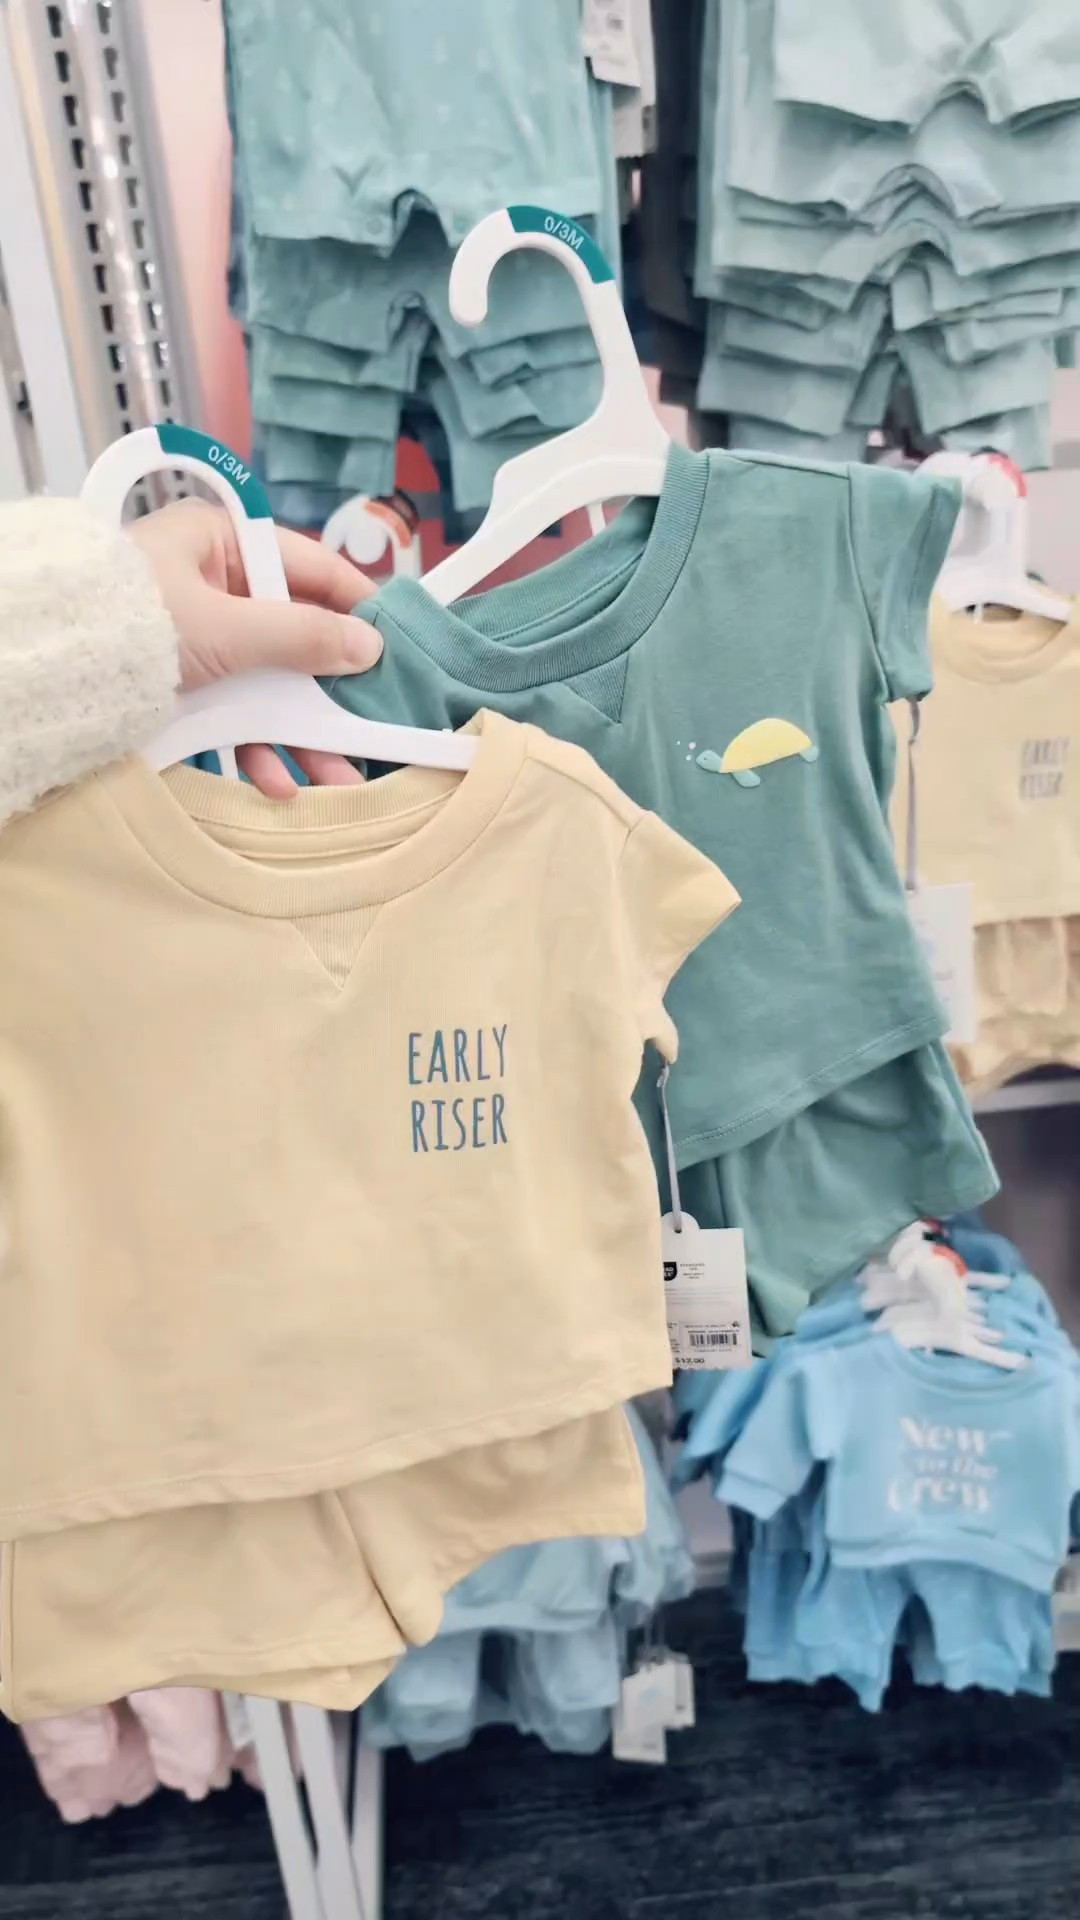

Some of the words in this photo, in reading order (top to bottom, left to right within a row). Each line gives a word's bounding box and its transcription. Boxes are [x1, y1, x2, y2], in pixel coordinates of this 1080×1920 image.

[543, 215, 585, 250] 0/3M
[207, 445, 251, 486] 0/3M
[408, 1023, 508, 1085] EARLY
[411, 1093, 508, 1153] RISER
[897, 1416, 1013, 1457] New
[887, 1475, 992, 1514] Crew
